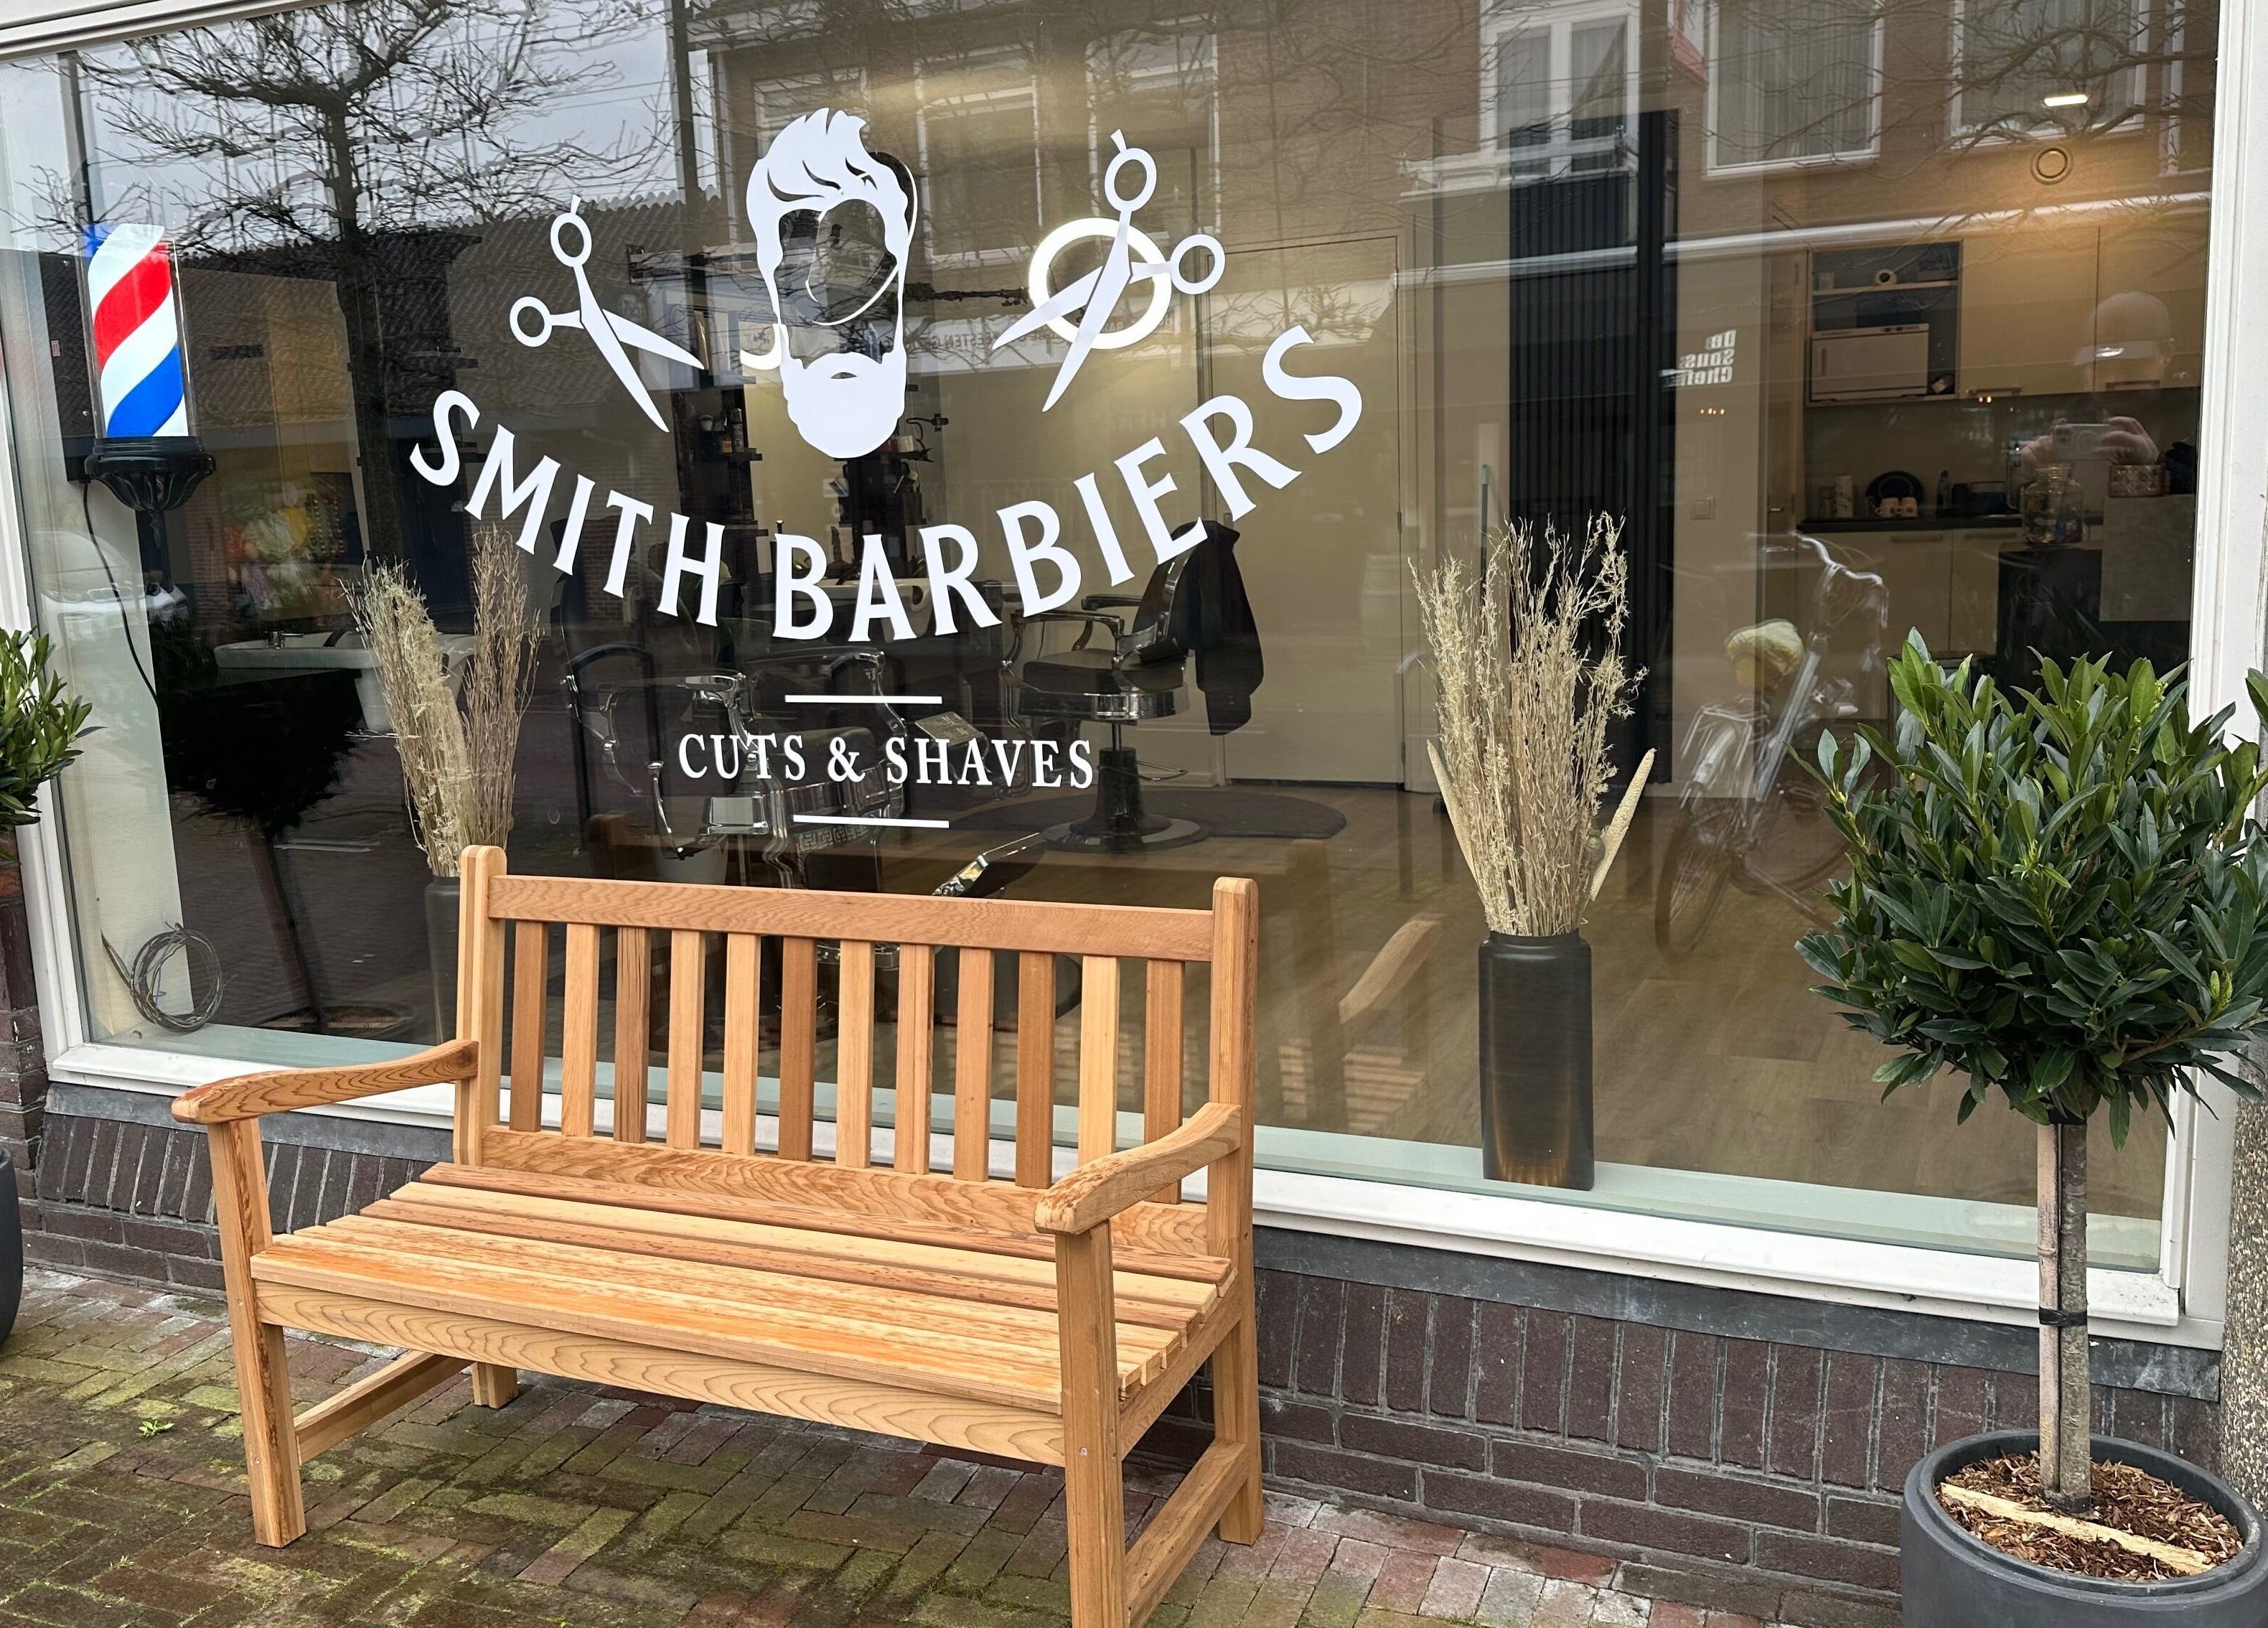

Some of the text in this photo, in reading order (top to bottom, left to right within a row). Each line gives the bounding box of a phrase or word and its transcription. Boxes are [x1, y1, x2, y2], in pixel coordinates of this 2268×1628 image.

[408, 323, 1364, 643] SMITH BARBIERS
[678, 732, 1094, 790] CUTS & SHAVES
